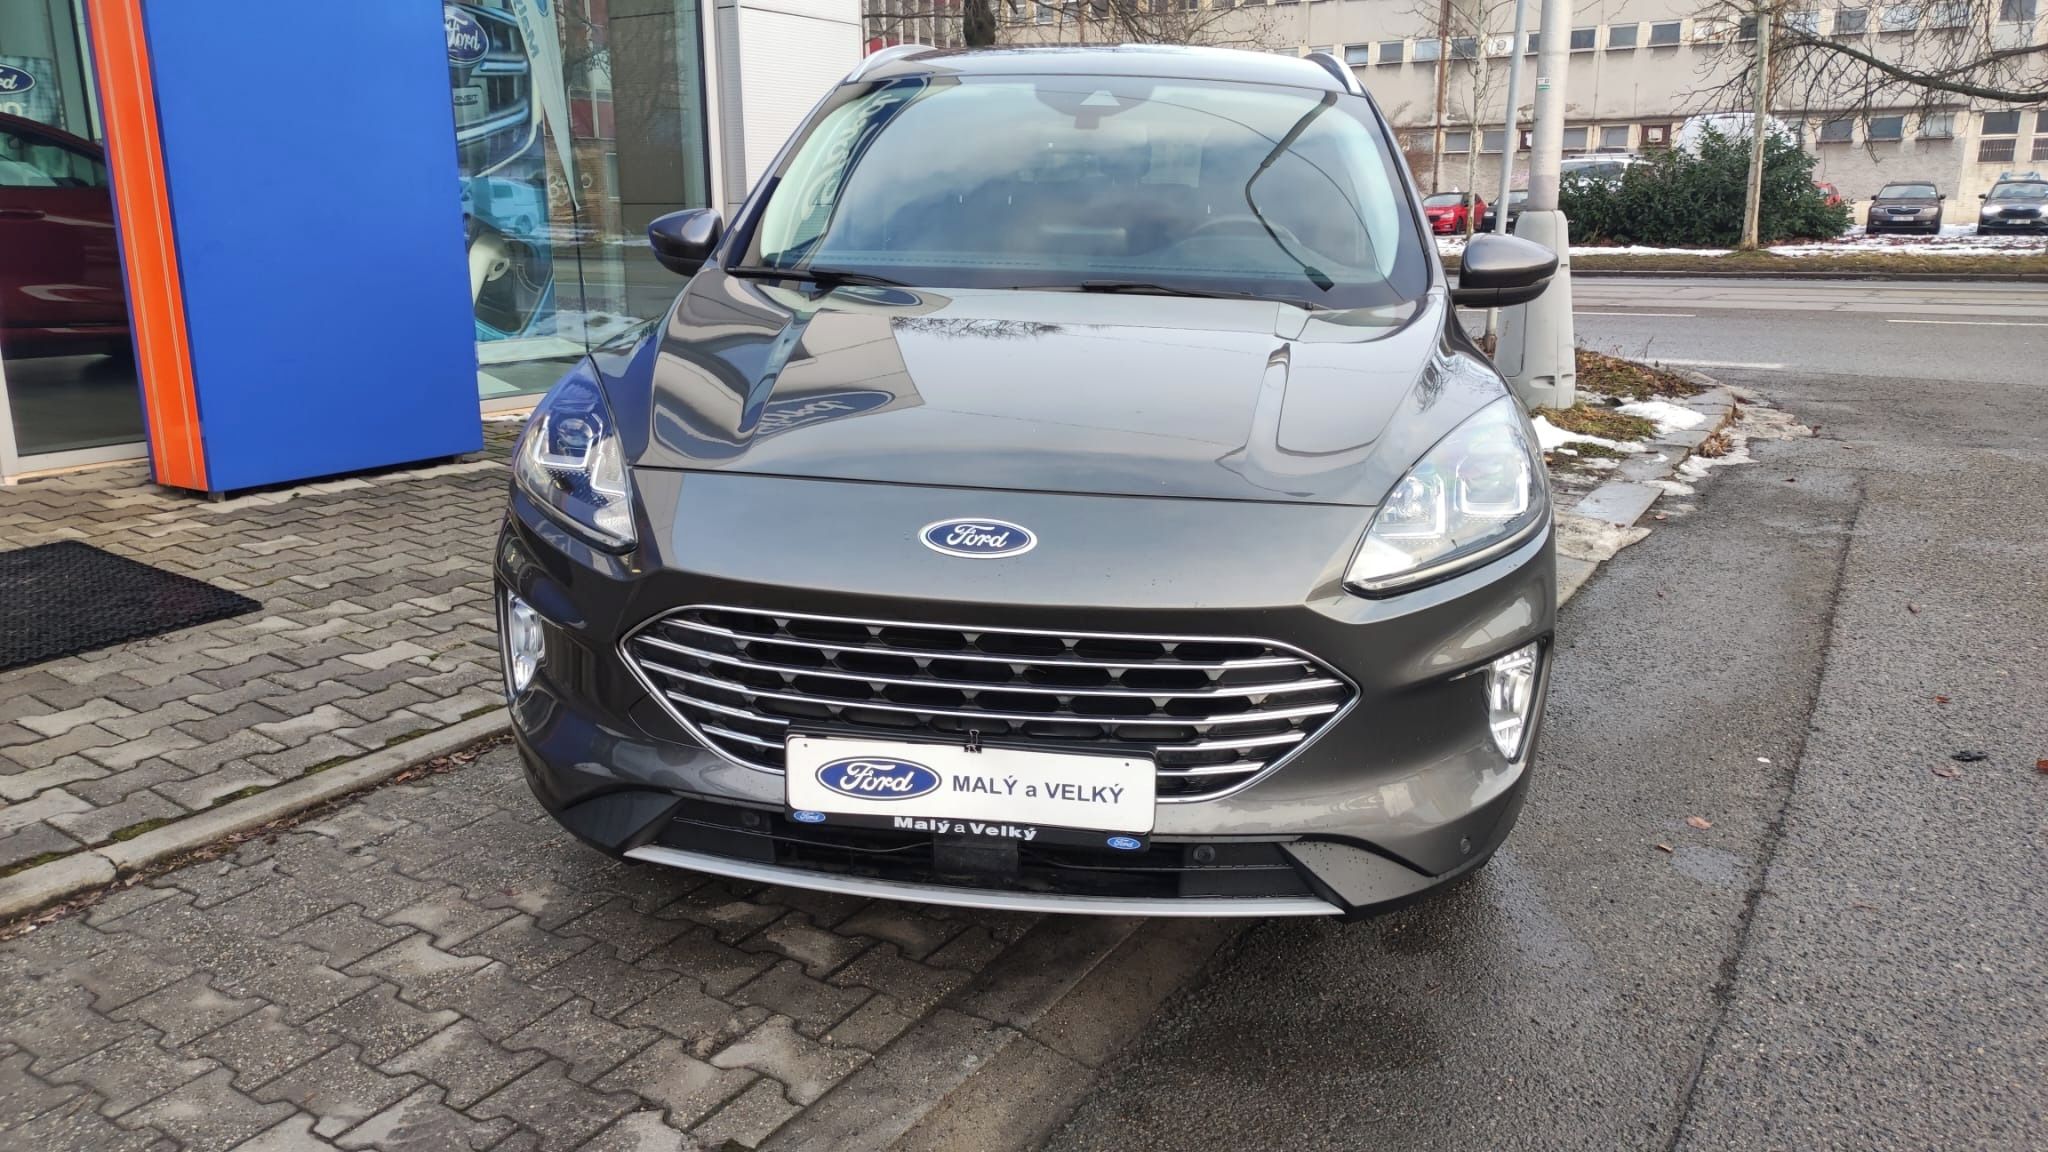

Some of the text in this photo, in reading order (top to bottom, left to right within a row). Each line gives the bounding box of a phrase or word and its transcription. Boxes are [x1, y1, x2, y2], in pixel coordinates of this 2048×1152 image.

[444, 14, 480, 50] Ford
[946, 524, 1010, 548] Ford
[839, 762, 1124, 804] Ford MALÝ a VELKÝ
[894, 816, 1038, 841] Malý a Velký
